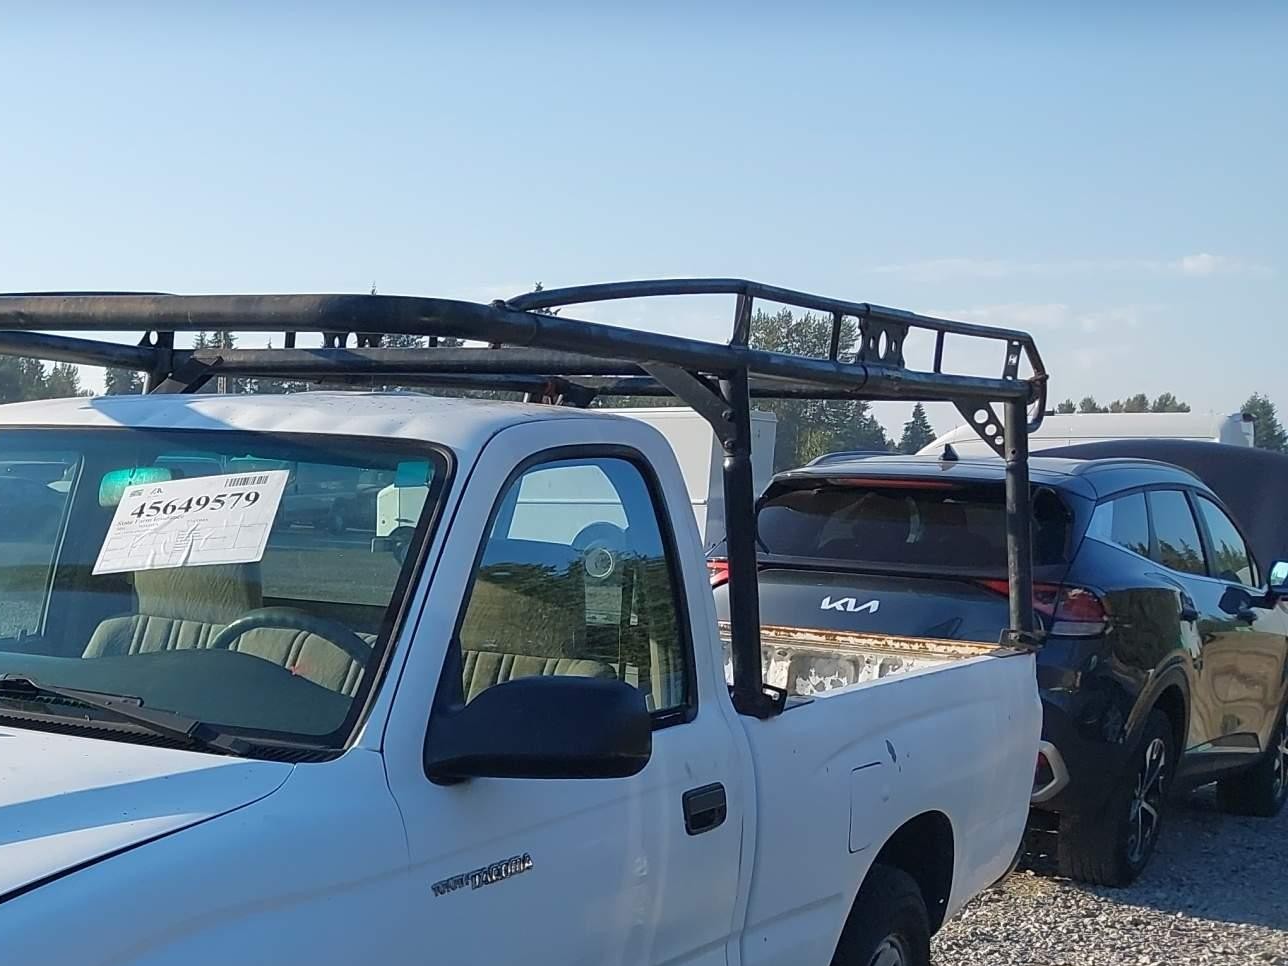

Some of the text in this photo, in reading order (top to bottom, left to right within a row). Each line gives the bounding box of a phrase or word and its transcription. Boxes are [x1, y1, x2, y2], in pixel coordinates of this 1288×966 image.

[130, 491, 260, 518] 45649579
[820, 595, 881, 614] KIA
[469, 853, 534, 890] TACOMA
